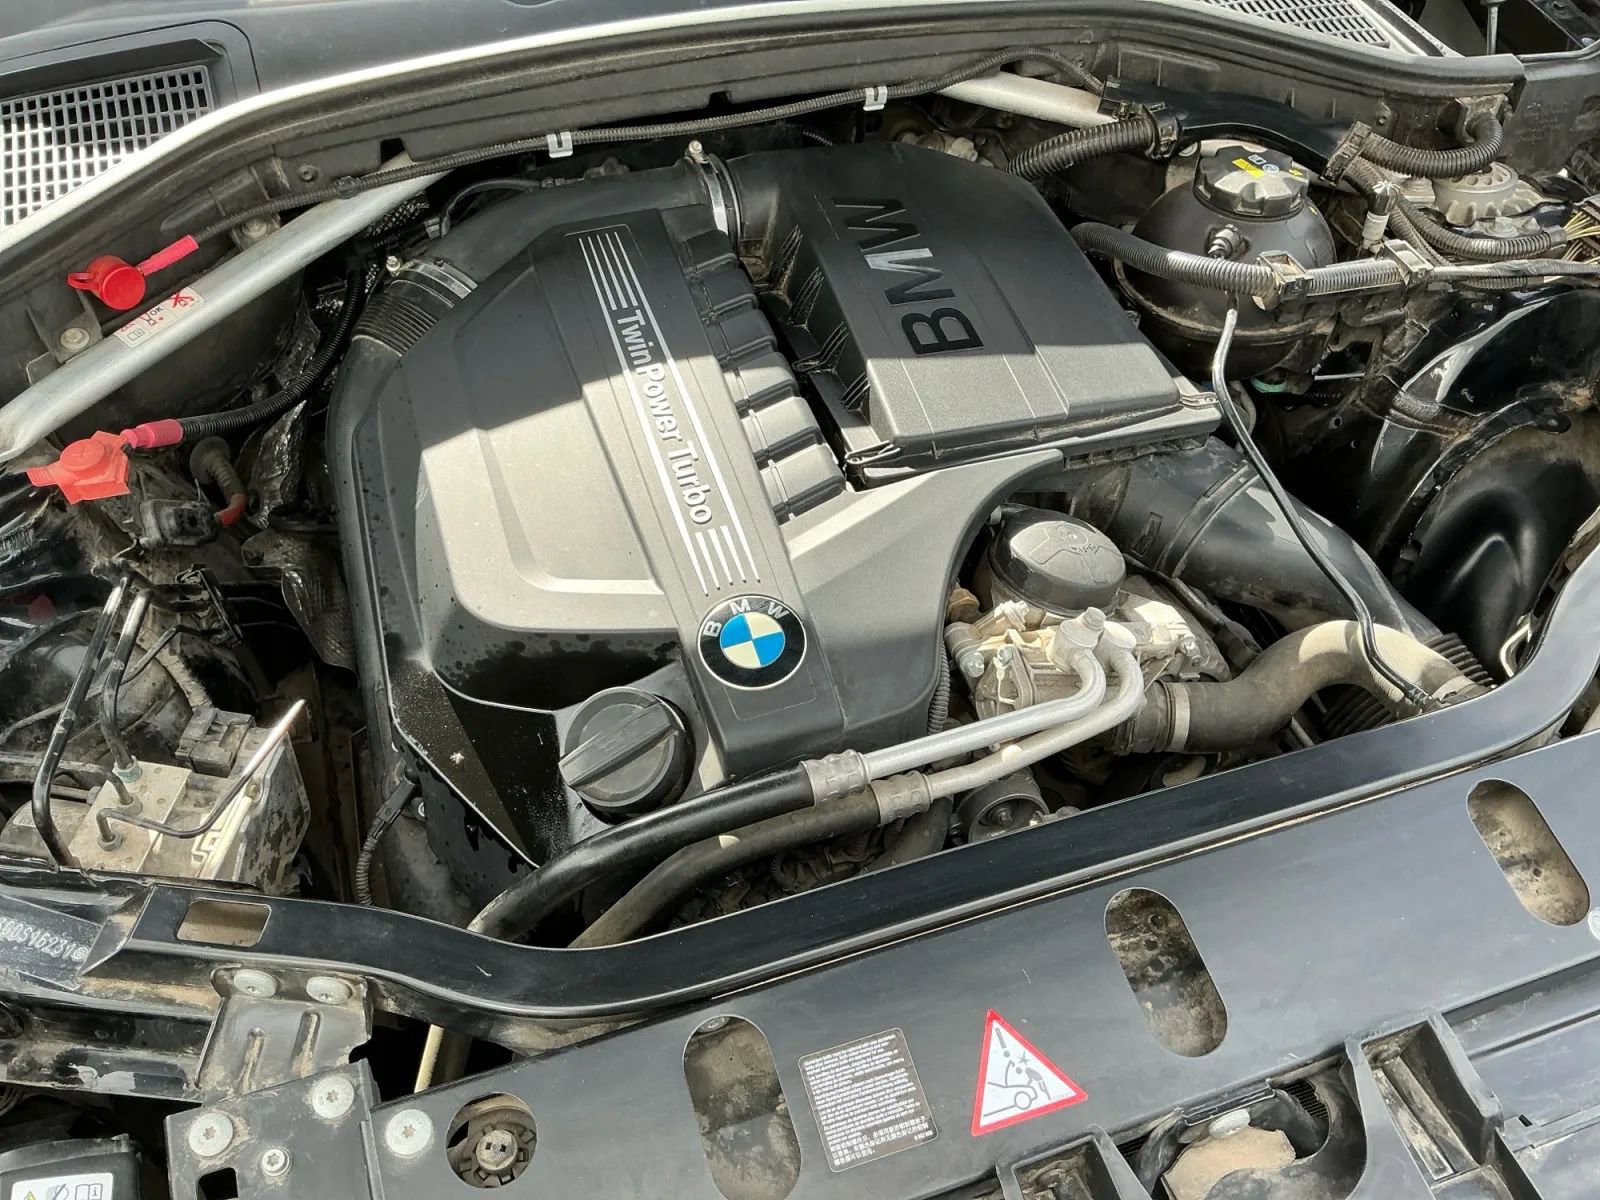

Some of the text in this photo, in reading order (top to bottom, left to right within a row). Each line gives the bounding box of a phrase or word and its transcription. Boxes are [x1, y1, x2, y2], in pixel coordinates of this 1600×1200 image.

[150, 306, 164, 316] OK
[832, 198, 984, 355] BMW
[617, 309, 713, 525] TwinPower Turbo
